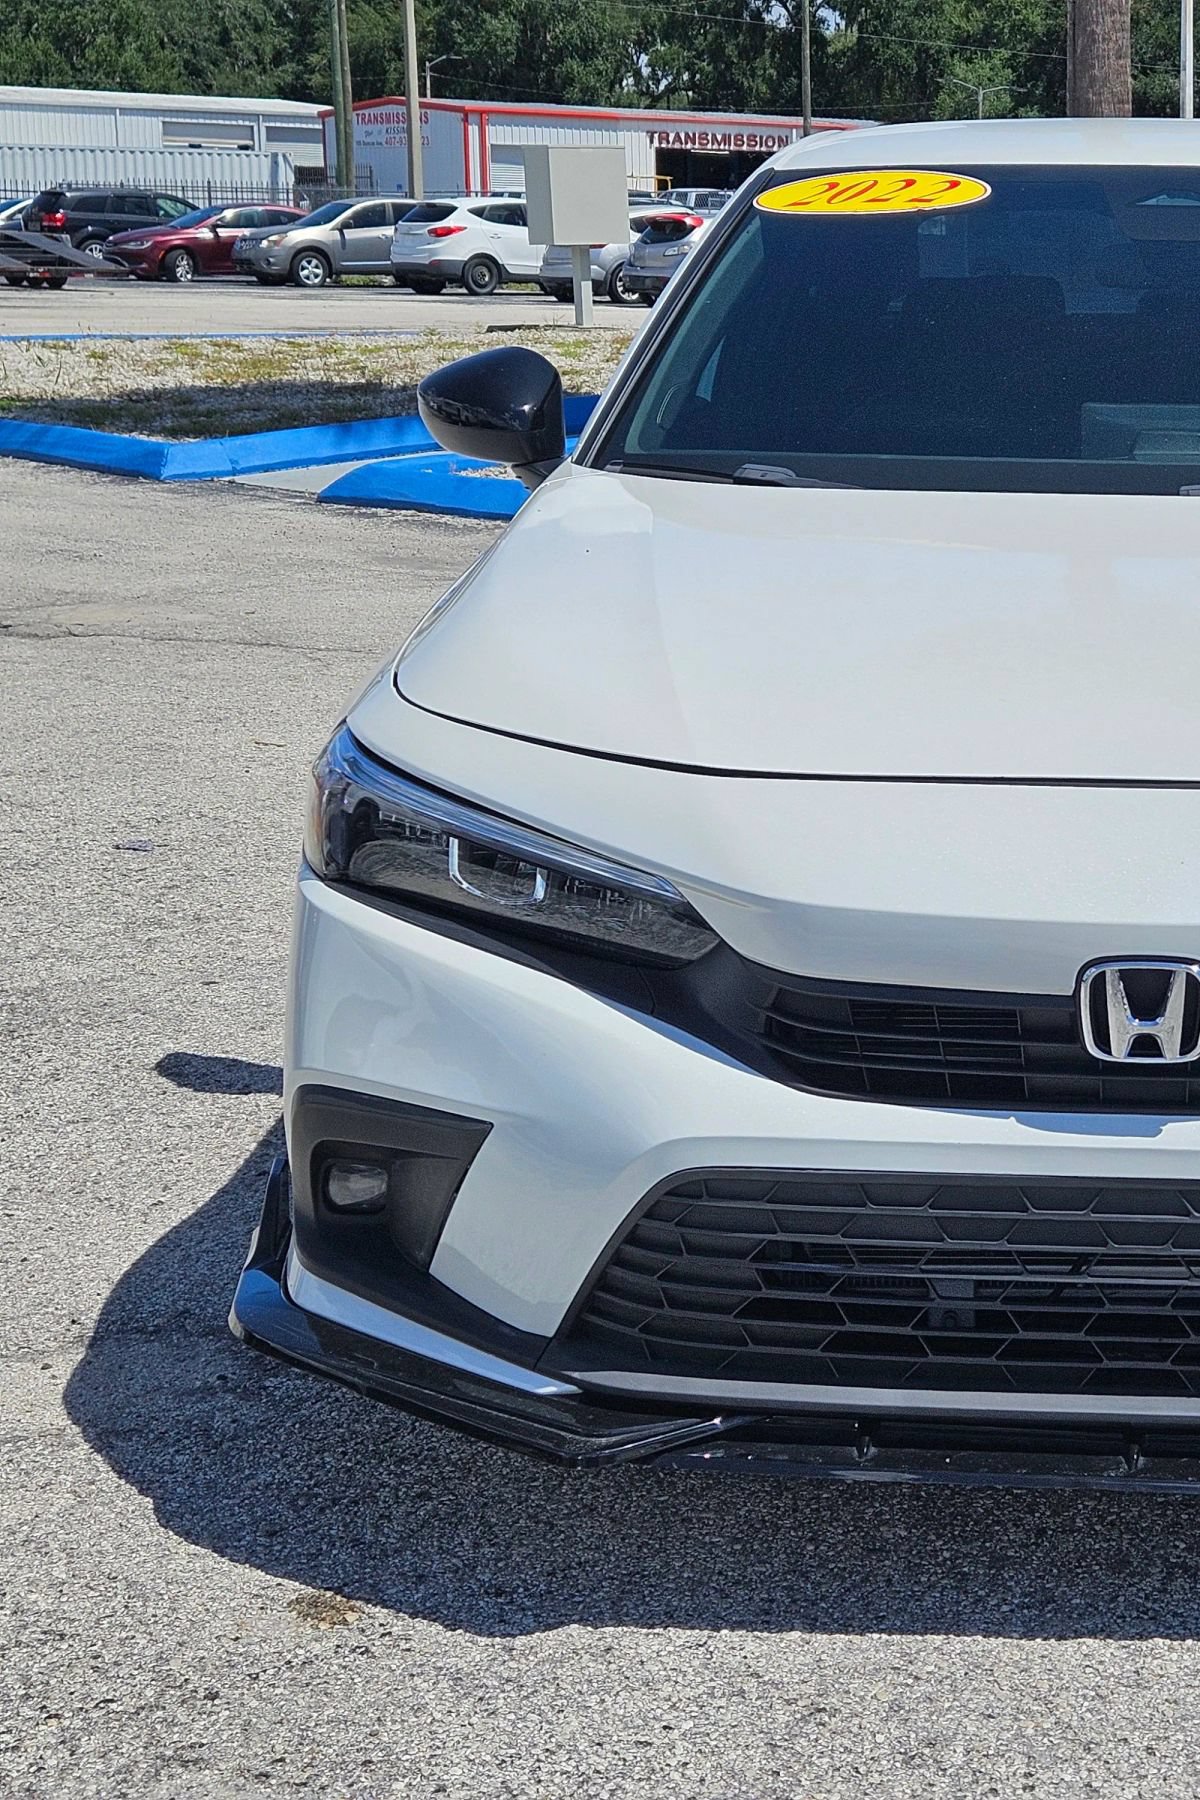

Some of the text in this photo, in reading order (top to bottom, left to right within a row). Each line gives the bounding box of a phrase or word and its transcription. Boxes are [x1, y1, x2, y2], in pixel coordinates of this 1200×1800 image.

[356, 112, 429, 125] TRANSMISSS
[646, 130, 789, 149] TRANSMISSION
[783, 178, 961, 207] 2022
